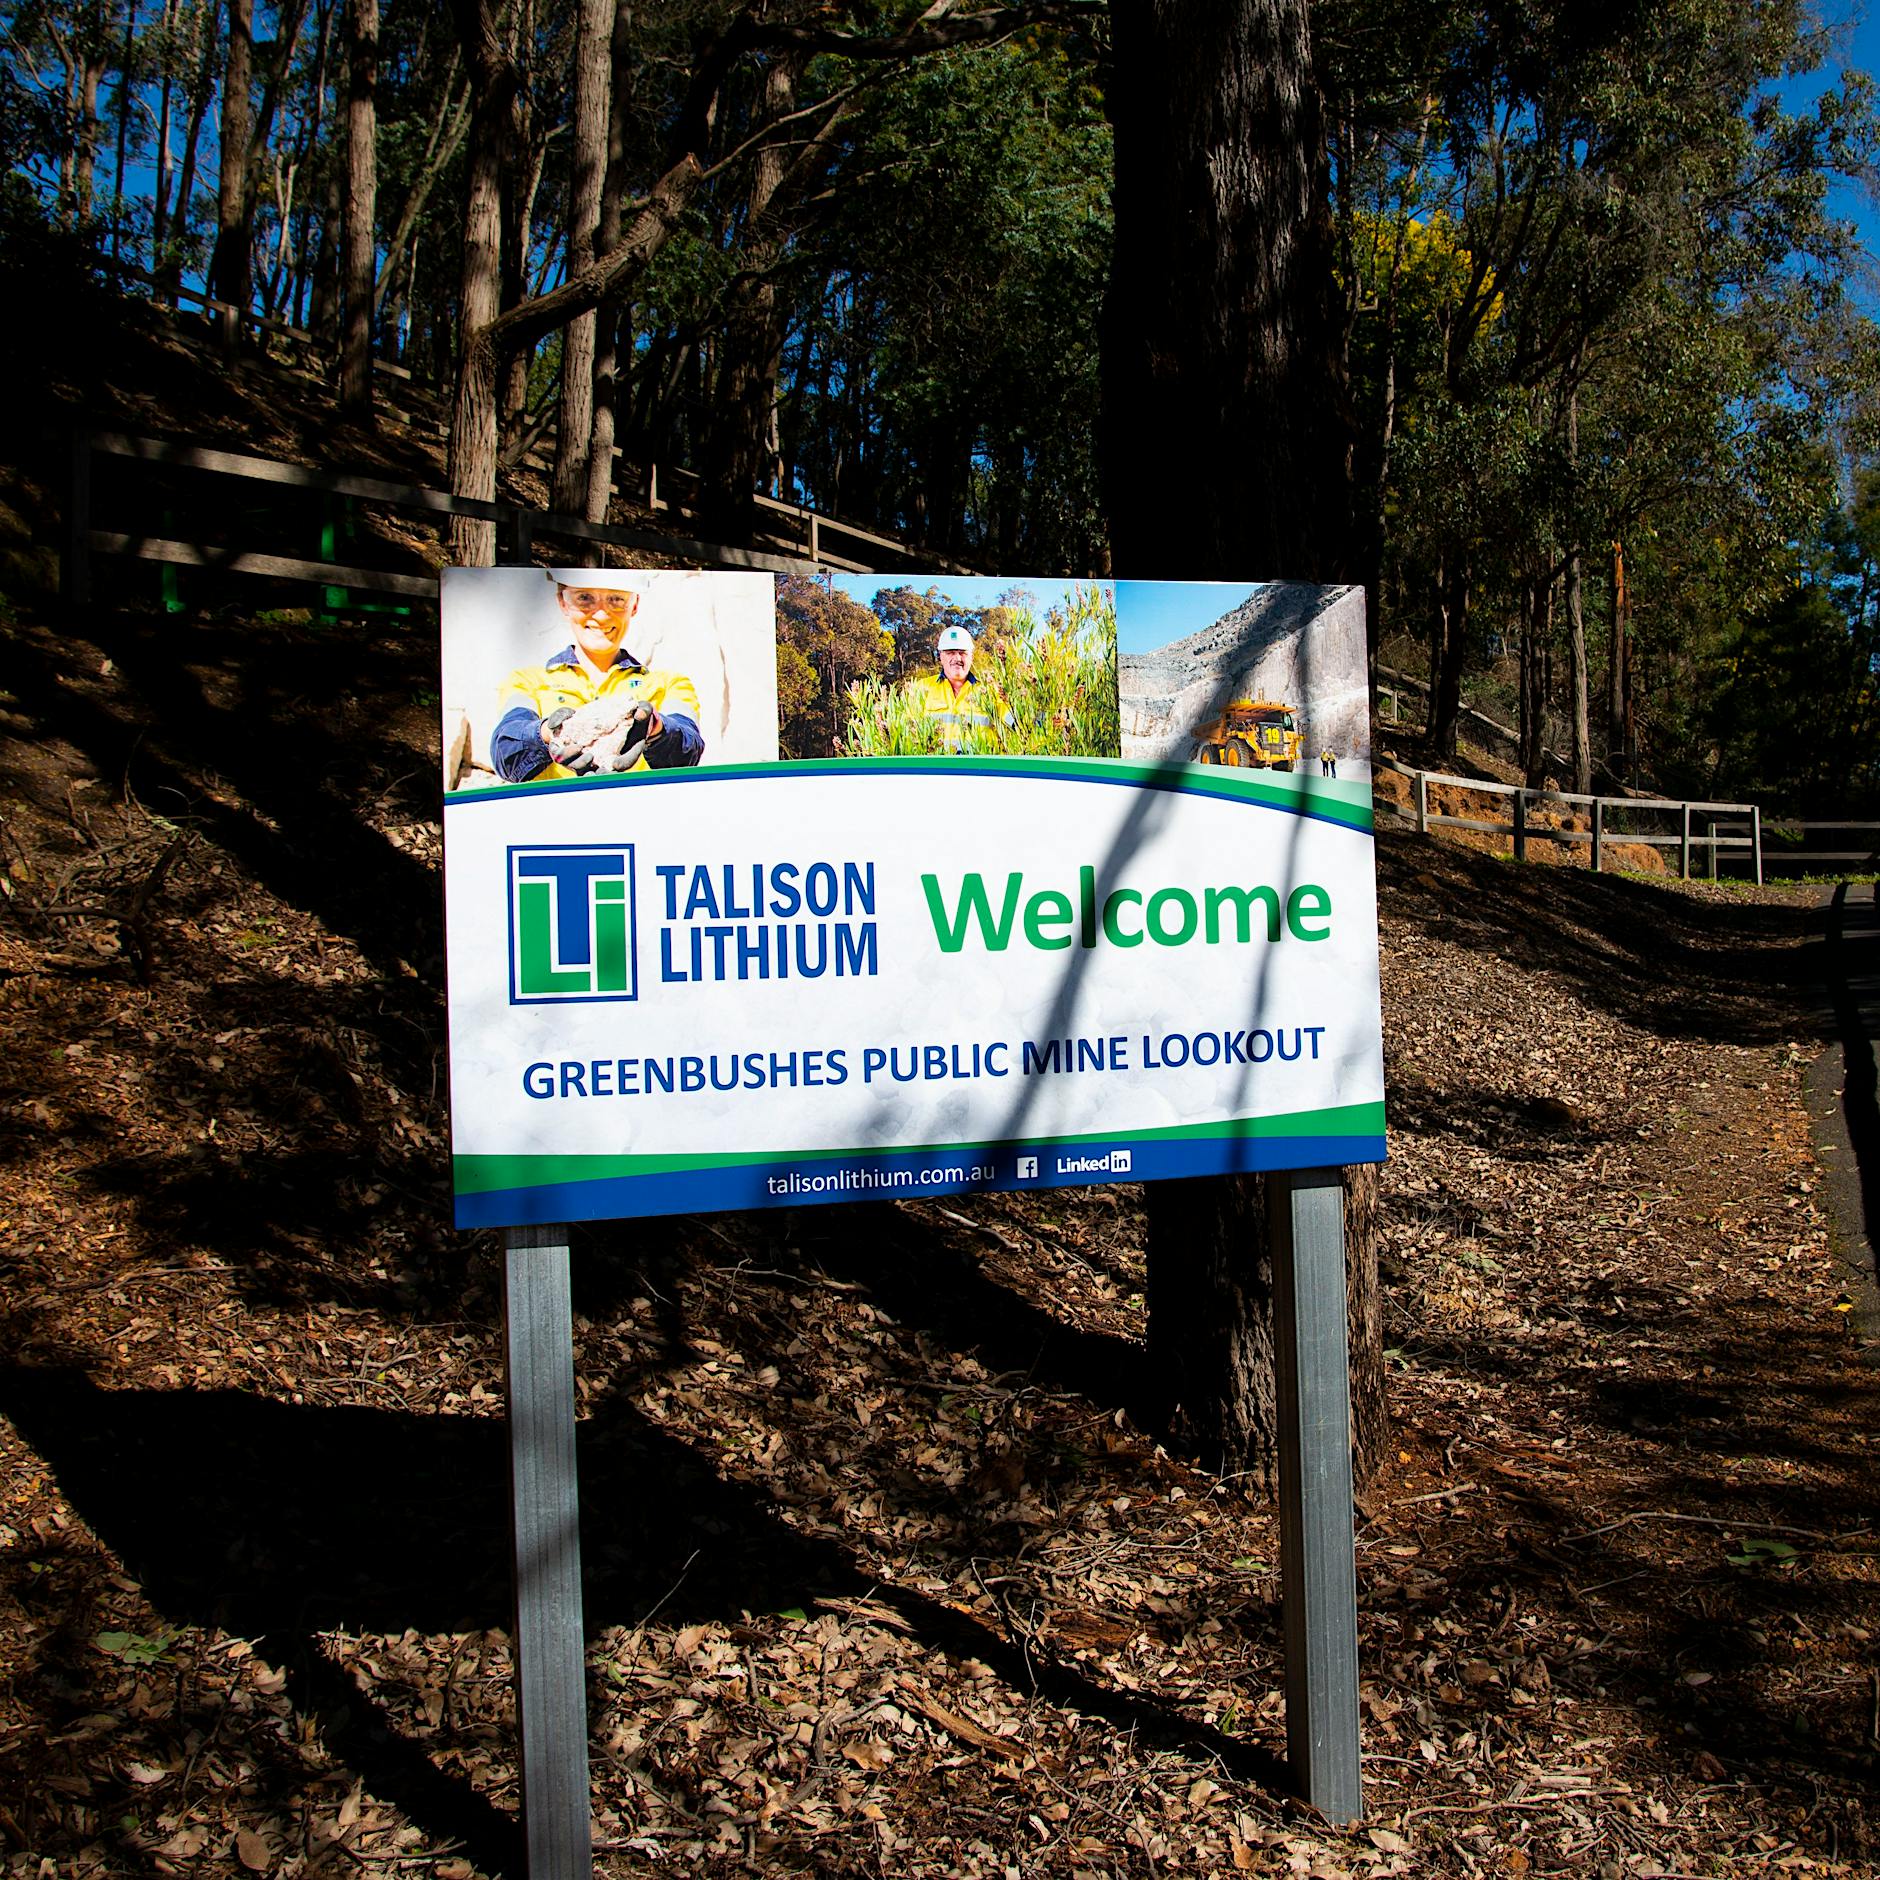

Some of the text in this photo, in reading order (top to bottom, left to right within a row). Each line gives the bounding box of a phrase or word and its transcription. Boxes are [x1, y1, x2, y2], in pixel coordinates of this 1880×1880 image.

[656, 862, 875, 920] TALISON
[921, 865, 1332, 952] Welcome
[661, 922, 878, 982] LITHIUM
[523, 1027, 1325, 1099] GREENBUSHES PUBLIC MINE LOOKOUT
[767, 1166, 995, 1194] talisonlithium.com.au
